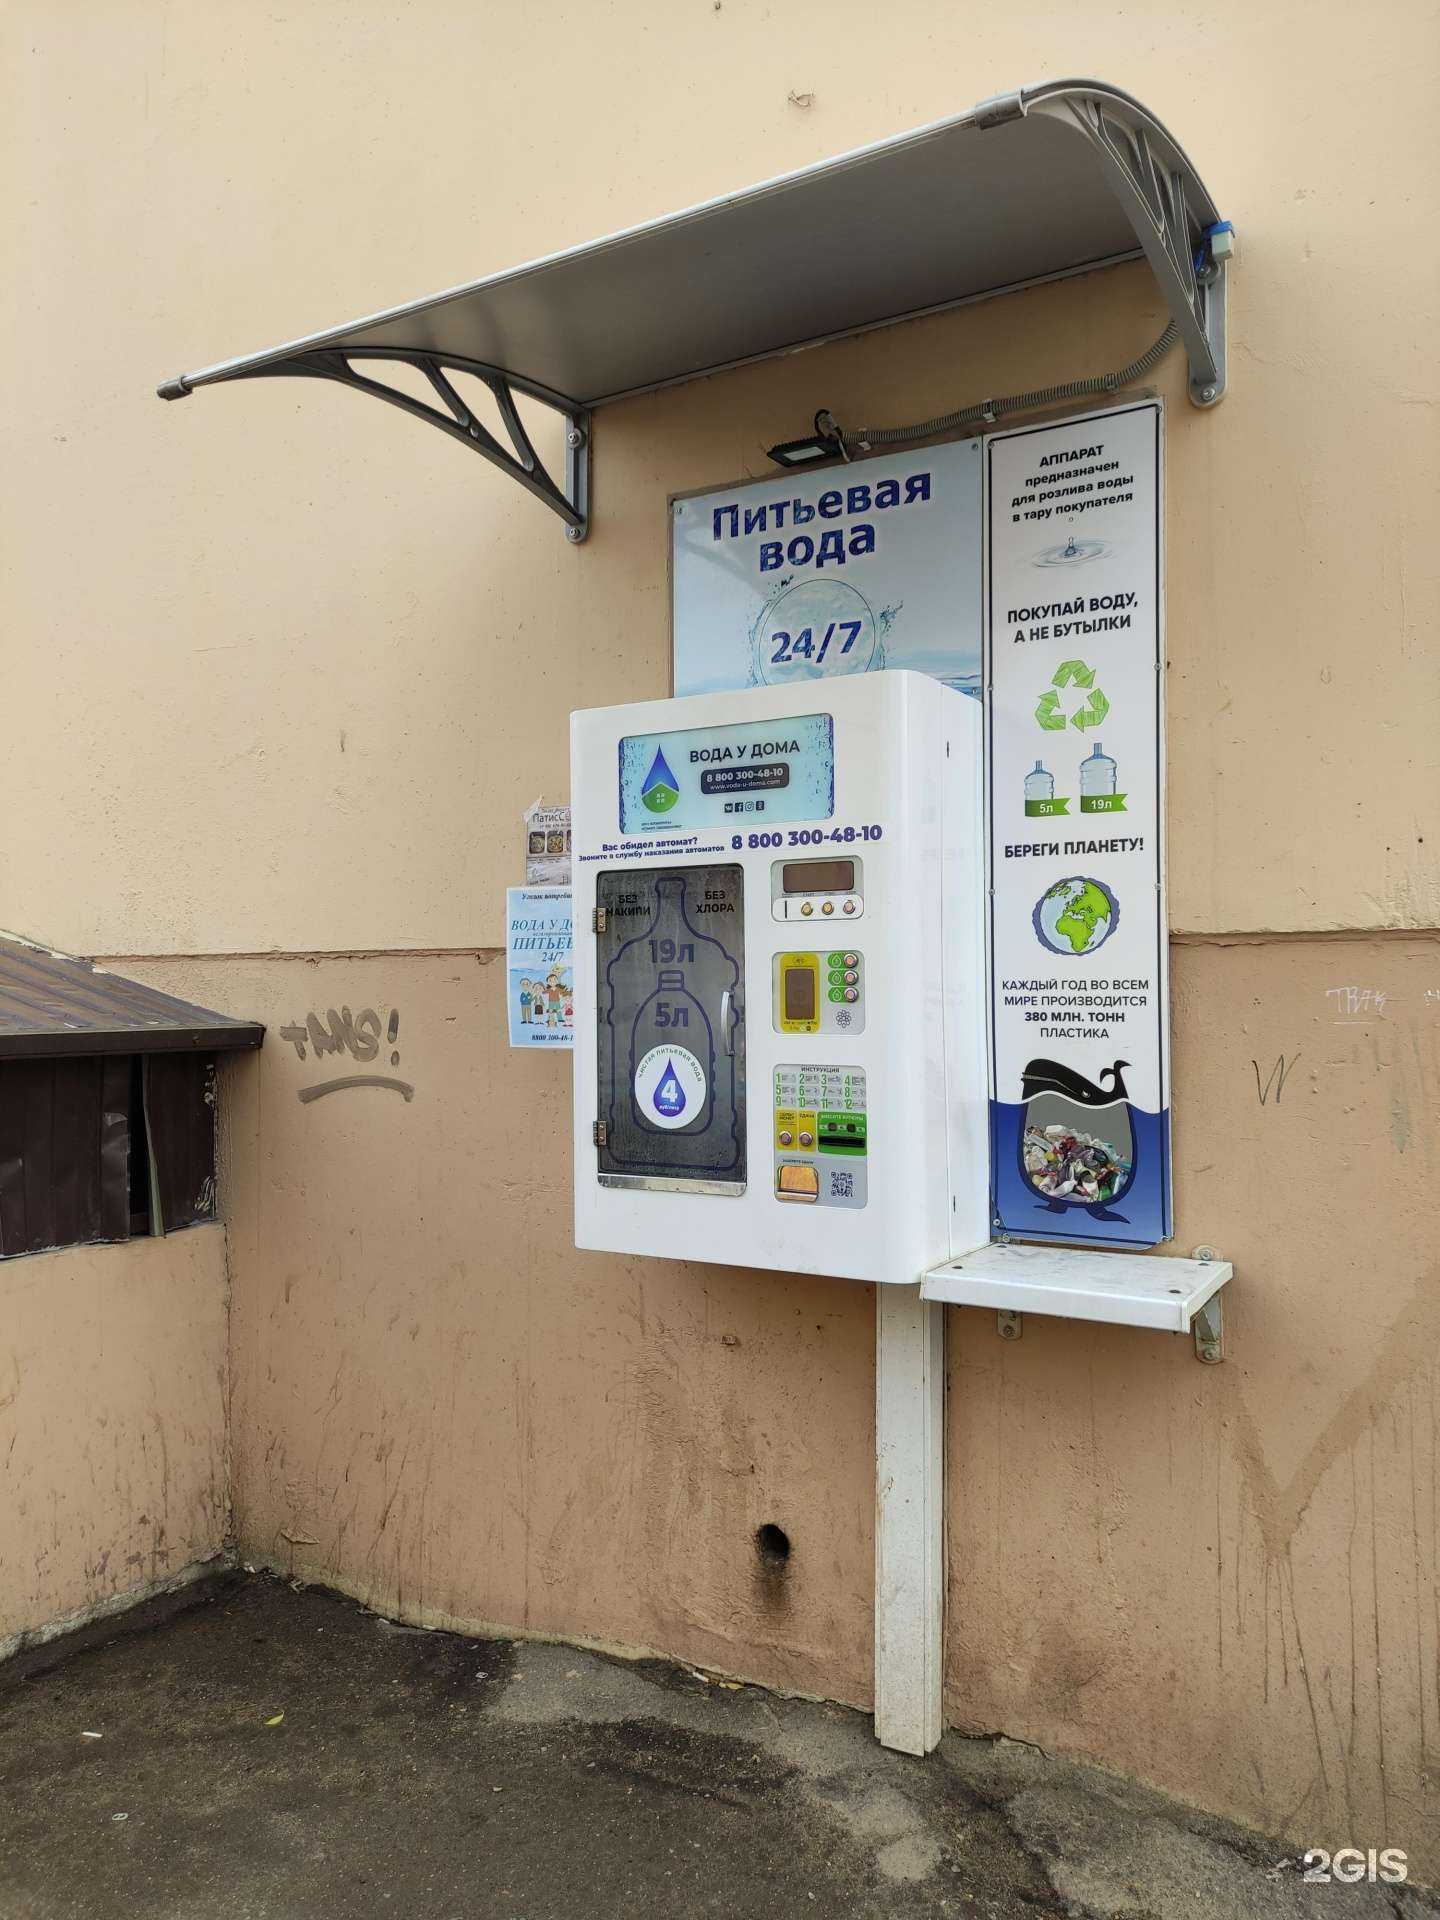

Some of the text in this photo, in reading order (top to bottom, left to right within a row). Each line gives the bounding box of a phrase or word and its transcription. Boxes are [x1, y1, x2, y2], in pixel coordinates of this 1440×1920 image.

[1039, 445, 1104, 467] АППАРАТ
[1025, 461, 1120, 488] предназначен
[1011, 475, 1134, 508] для розлива воды
[713, 472, 931, 540] Питьевая
[1012, 492, 1134, 522] в тару покупателя
[760, 523, 875, 572] вода
[1007, 592, 1138, 624] ПОКУПАЙ ВОДУ,
[1014, 614, 1132, 644] А НЕ БУТЫЛКИ
[770, 620, 862, 664] 24/7
[689, 740, 800, 763] ВОДА У ДОМА
[706, 767, 784, 782] 8 800 300-48-10
[1039, 804, 1054, 814] 5л
[1091, 800, 1112, 810] 19л
[602, 836, 698, 852] Вас обидел автомат?
[732, 824, 882, 850] 8 800 300-48-10
[615, 850, 642, 860] службу
[644, 848, 684, 857] наказания
[685, 845, 725, 854] автоматов
[1004, 838, 1144, 858] БЕРЕГИ ПЛАНЕТУ!
[618, 895, 638, 904] БЕЗ
[705, 890, 726, 900] БЕЗ
[696, 903, 734, 914] ХЛОРА
[511, 919, 572, 932] ВОДА У Д
[542, 952, 564, 962] 24/7
[649, 938, 695, 964] 19л
[1002, 978, 1150, 992] КАЖДЫЙ ГОД ВО ВСЕМ
[1004, 995, 1147, 1008] МИРЕ ПРОИЗВОДИТСЯ
[654, 1002, 688, 1028] 5л
[1024, 1012, 1126, 1022] 380 МЛН. ТОНН
[1040, 1027, 1110, 1039] ПЛАСТИКА
[800, 1074, 804, 1084] 2
[821, 1074, 826, 1084] 3
[844, 1075, 850, 1086] 4
[662, 1079, 678, 1102] 4
